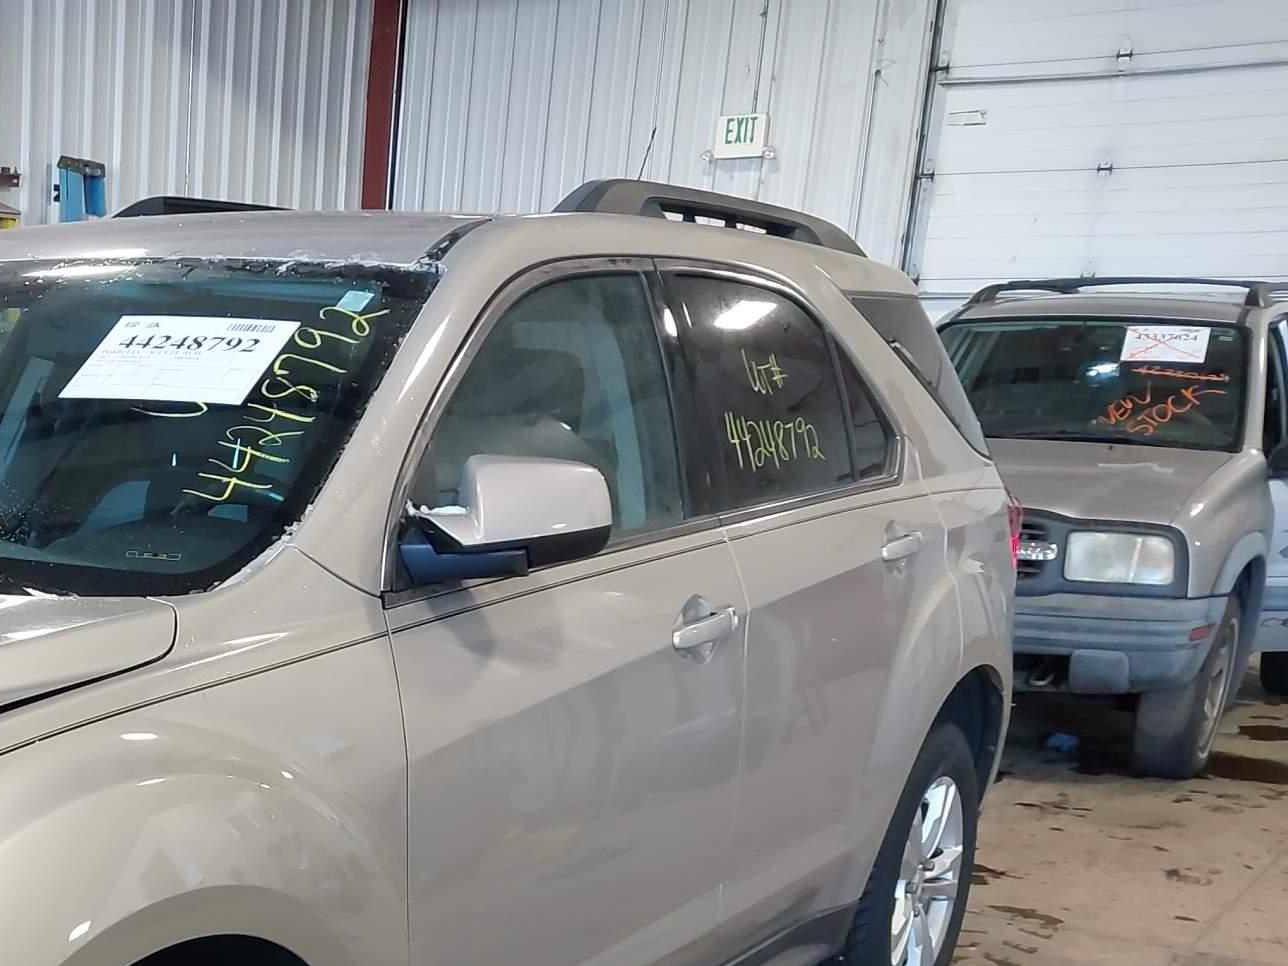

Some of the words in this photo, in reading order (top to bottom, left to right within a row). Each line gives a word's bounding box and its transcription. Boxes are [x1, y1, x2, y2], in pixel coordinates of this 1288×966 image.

[724, 116, 758, 145] EXIT
[118, 334, 261, 353] 44248792
[181, 306, 391, 501] 44248792
[1126, 384, 1227, 436] STOCK
[724, 411, 827, 473] 44248792
